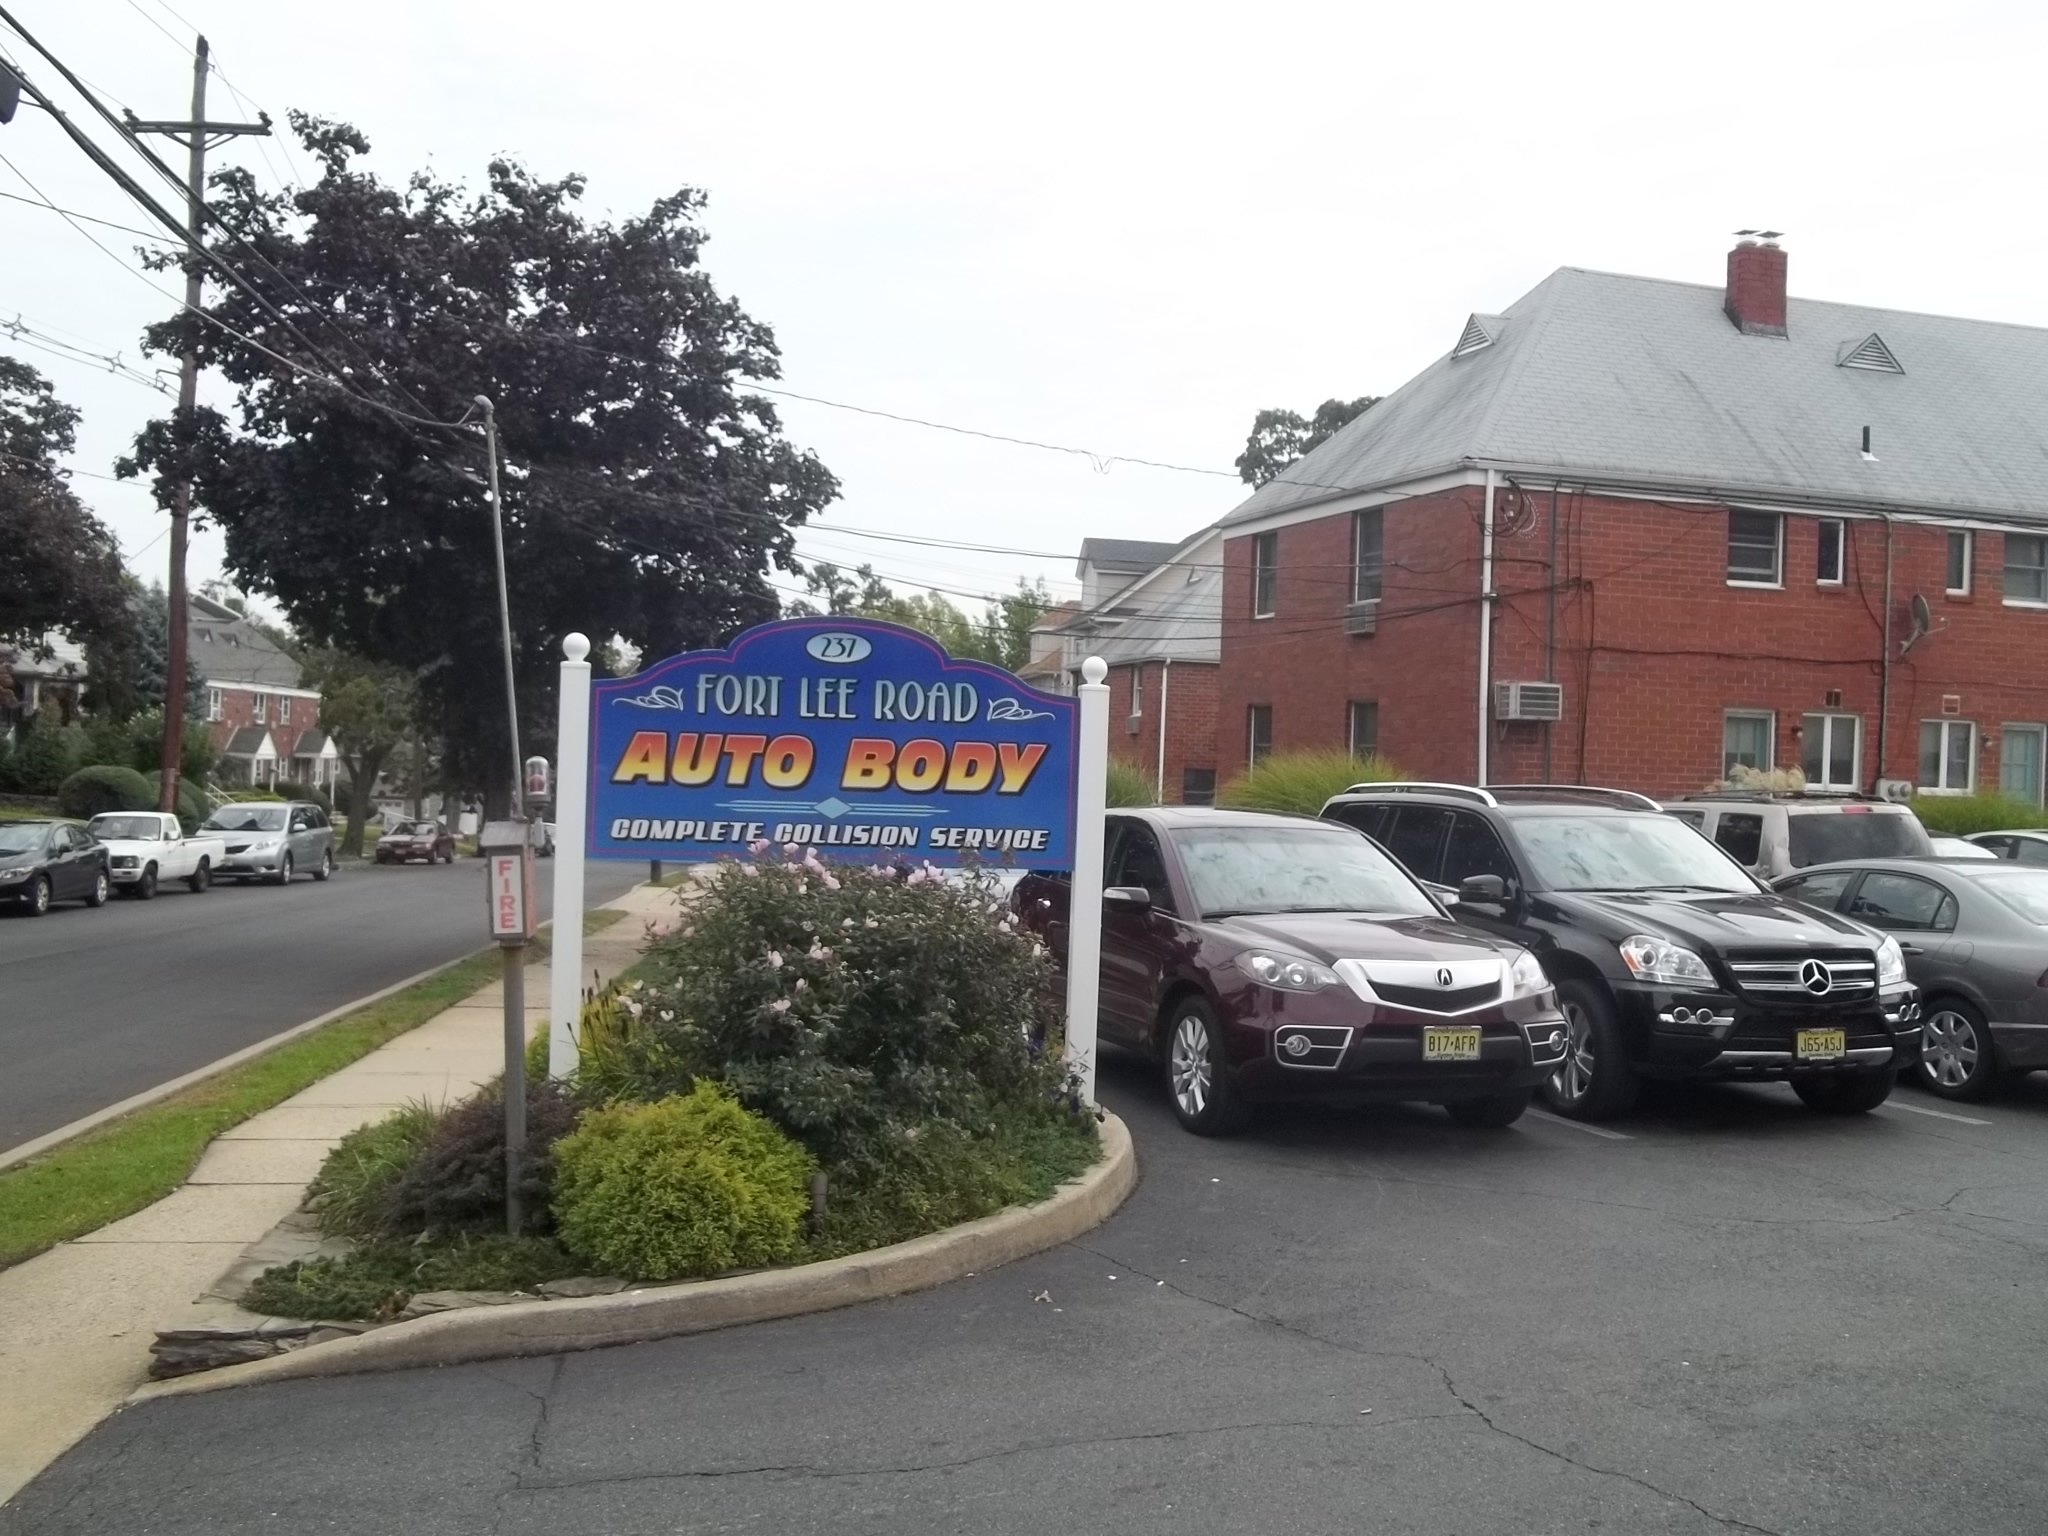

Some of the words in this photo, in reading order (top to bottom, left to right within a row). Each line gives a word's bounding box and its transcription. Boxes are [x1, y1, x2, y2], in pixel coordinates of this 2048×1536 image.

[822, 636, 857, 659] 237
[697, 673, 783, 717] FORT
[800, 678, 859, 720] LEE
[875, 682, 978, 723] ROAD
[610, 731, 815, 789] AUTO
[840, 738, 1049, 796] BODY
[610, 818, 764, 844] COMPLETE
[774, 823, 919, 848] COLLISION
[929, 828, 1050, 851] SERVICE
[498, 860, 516, 929] FIRE
